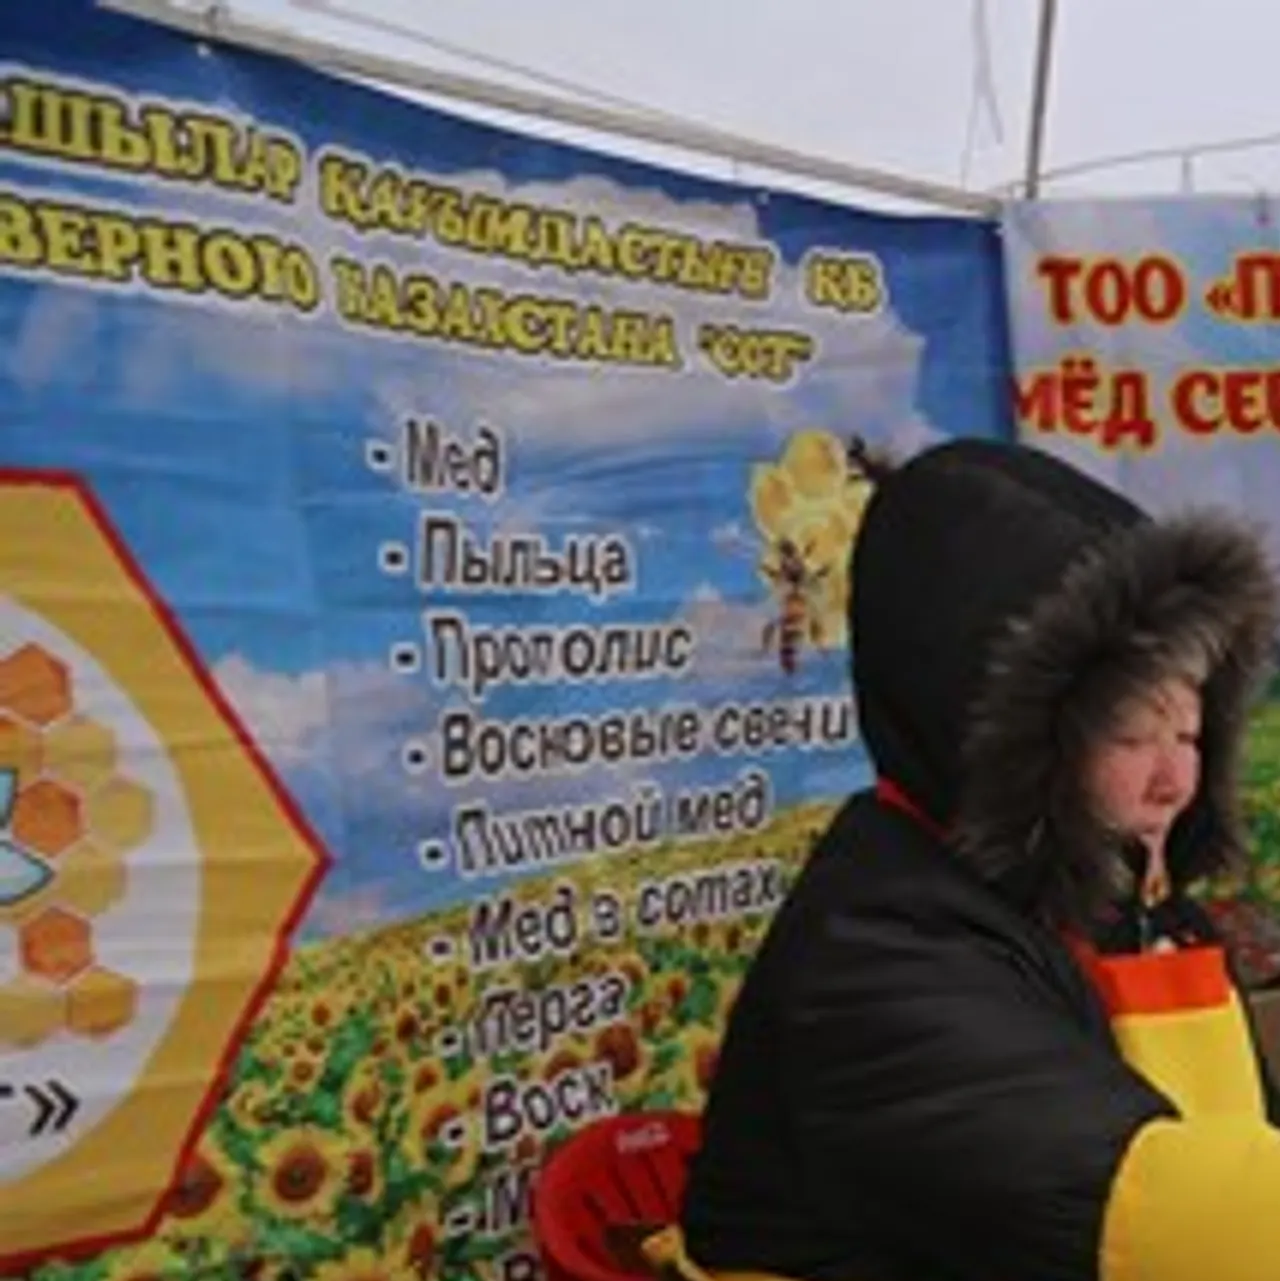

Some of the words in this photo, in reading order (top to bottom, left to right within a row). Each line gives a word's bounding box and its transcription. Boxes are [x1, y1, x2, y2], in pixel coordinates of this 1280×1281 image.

[0, 76, 302, 204] ШЫЛАР
[1036, 253, 1185, 325] ТОО
[406, 417, 499, 494] Мед
[422, 517, 631, 596] Пыльца
[442, 713, 699, 778] Восковые
[676, 772, 768, 835] мед
[469, 886, 578, 966] Мед
[474, 976, 627, 1053] Перга
[486, 1066, 616, 1144] Воск
